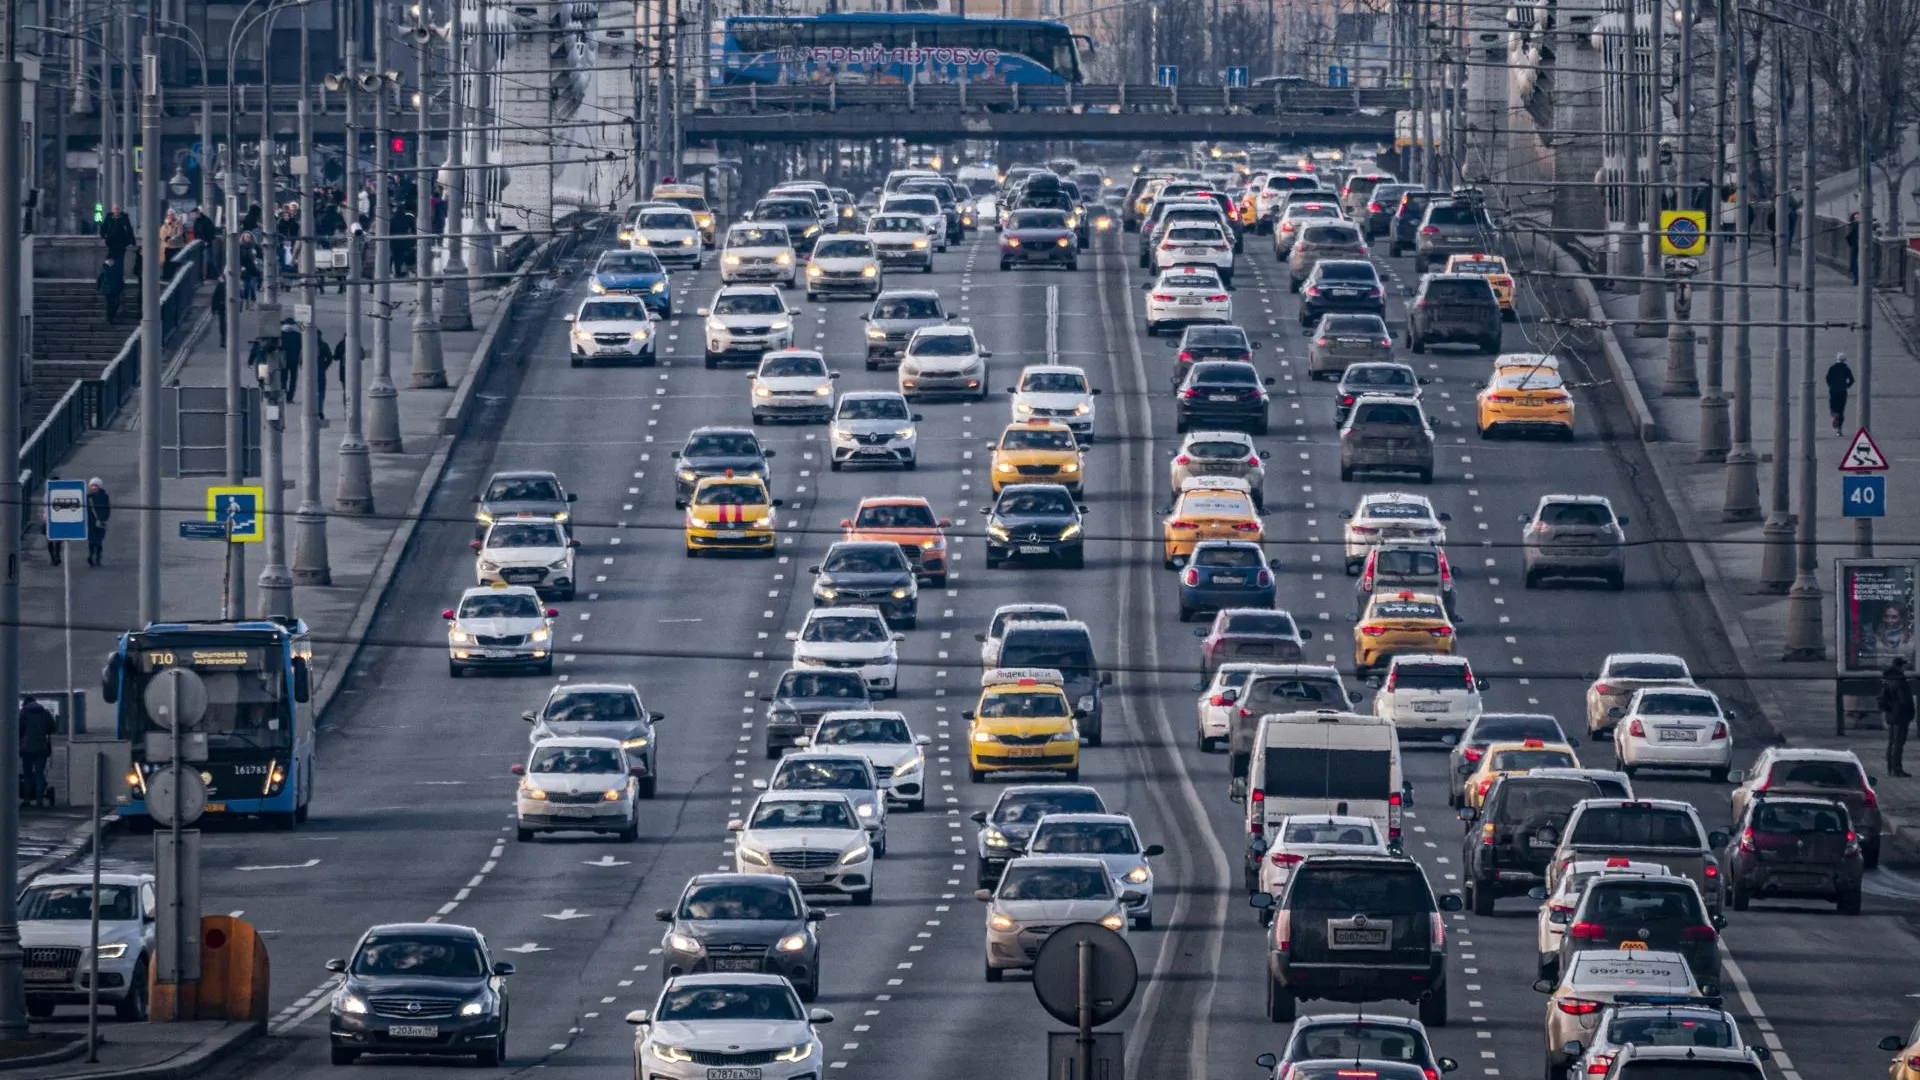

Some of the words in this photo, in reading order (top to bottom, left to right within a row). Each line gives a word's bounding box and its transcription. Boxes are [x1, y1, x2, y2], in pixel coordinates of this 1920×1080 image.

[776, 42, 887, 64] ДОБРЫЙ
[890, 47, 1000, 65] АВТОБУС
[1850, 486, 1875, 504] 40
[149, 652, 173, 665] Т10
[996, 670, 1025, 678] Яндекс
